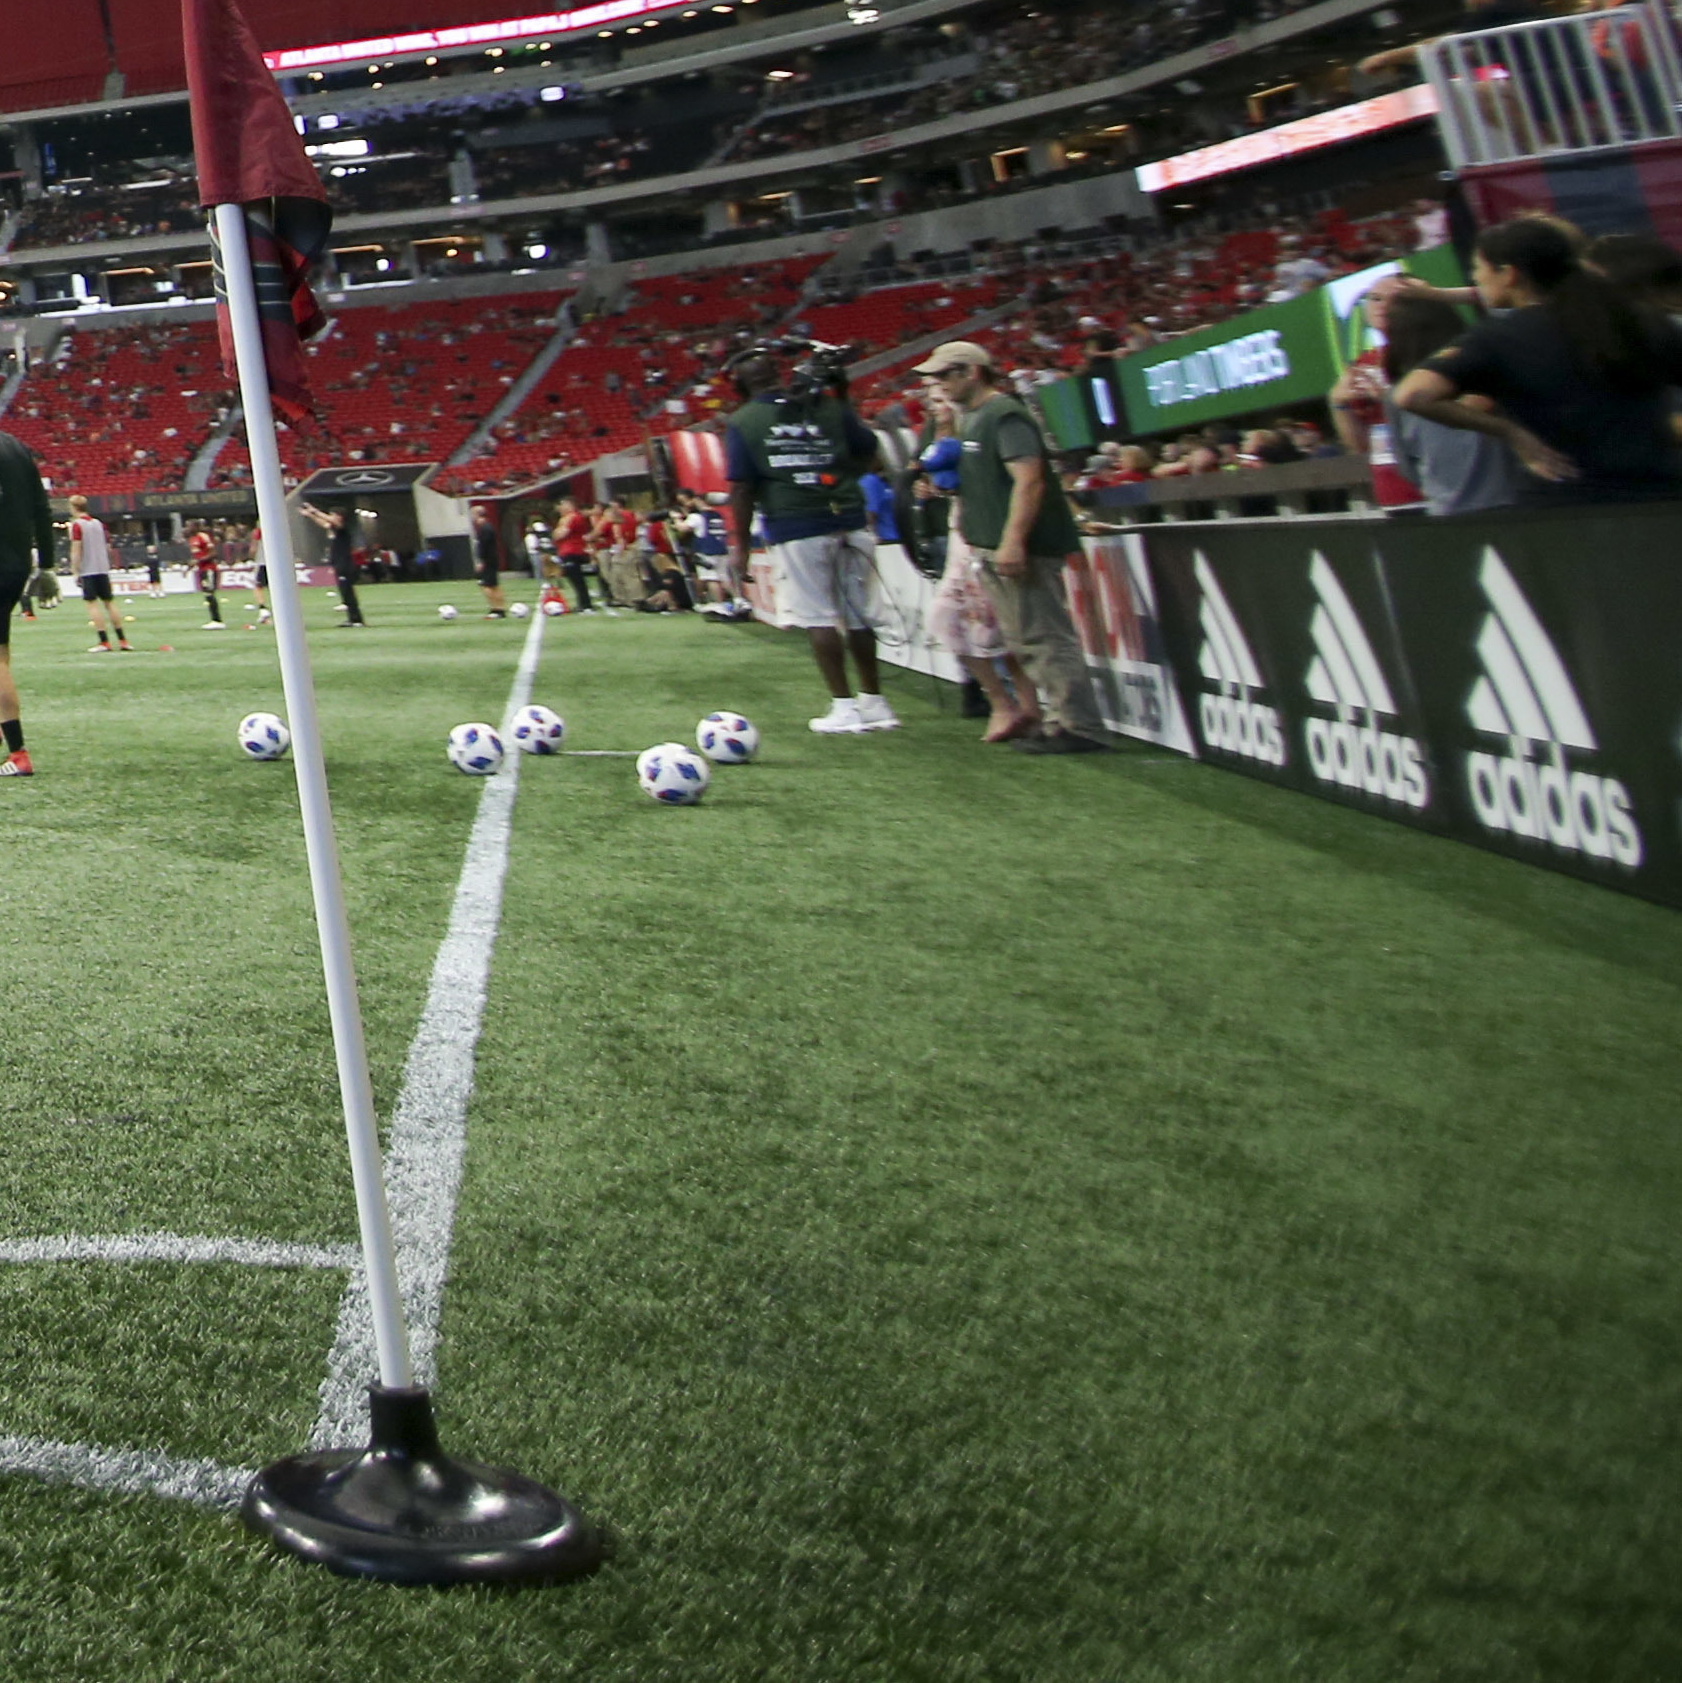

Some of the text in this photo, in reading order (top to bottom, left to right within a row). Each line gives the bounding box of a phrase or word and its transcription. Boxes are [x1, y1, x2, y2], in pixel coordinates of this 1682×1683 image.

[1198, 680, 1286, 767] adidas
[1304, 702, 1429, 809] adidas
[1466, 732, 1643, 868] adidas
